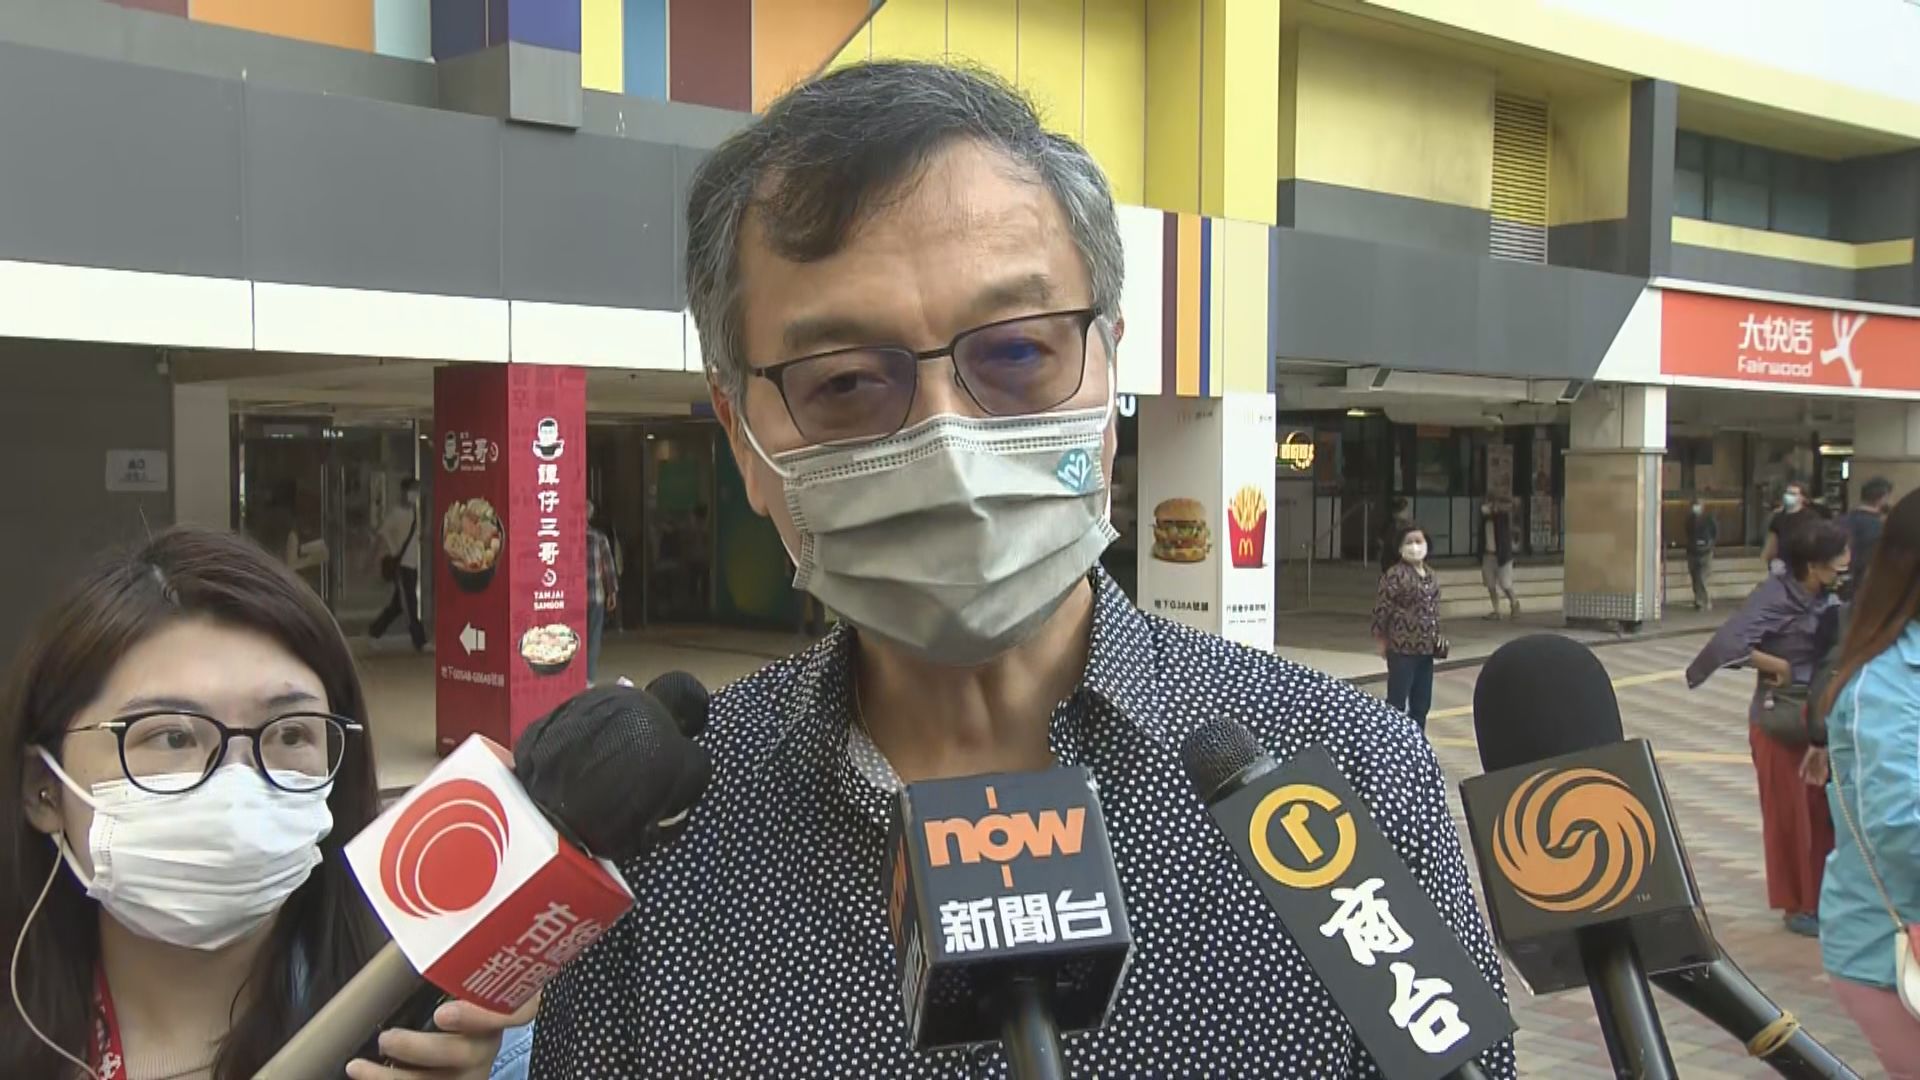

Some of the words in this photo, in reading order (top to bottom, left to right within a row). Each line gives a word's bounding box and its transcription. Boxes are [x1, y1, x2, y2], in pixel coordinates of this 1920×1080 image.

[1738, 313, 1814, 356] 大快活
[1737, 355, 1813, 378] Fairwood
[923, 806, 1086, 868] now
[938, 889, 1113, 953] 新聞台
